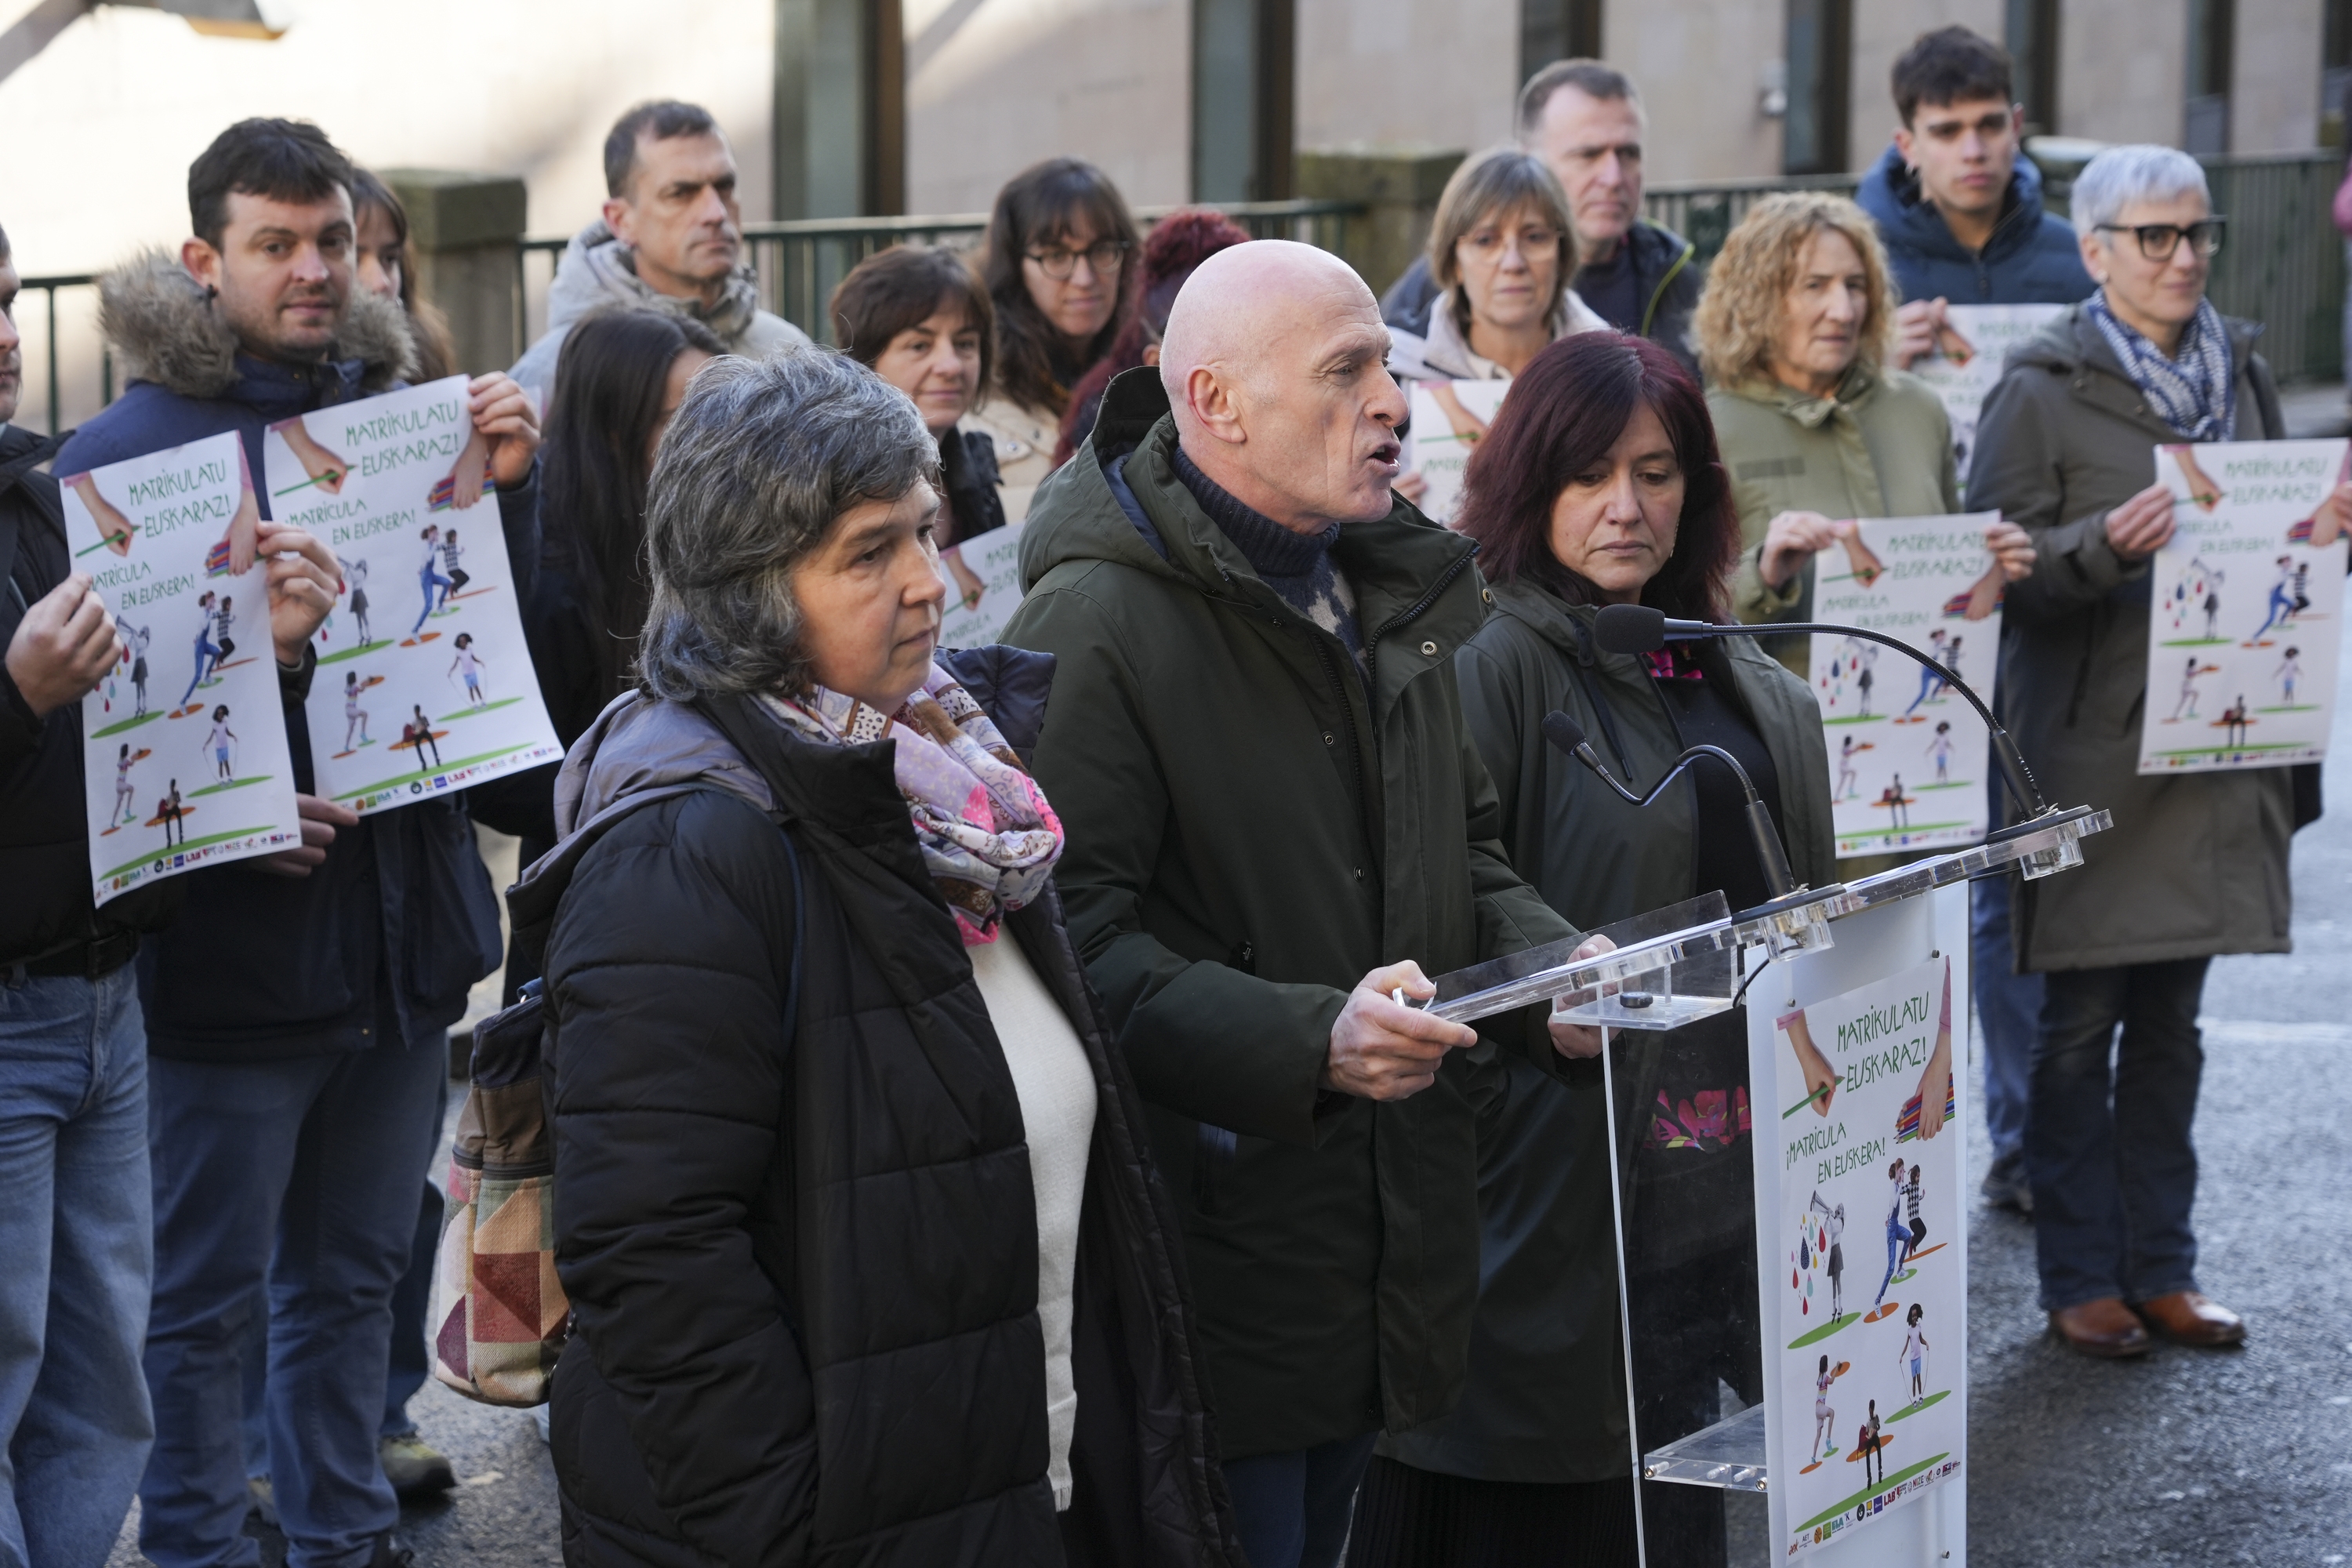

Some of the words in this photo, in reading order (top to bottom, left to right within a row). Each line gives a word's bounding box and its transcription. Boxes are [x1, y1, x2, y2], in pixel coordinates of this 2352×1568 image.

[361, 432, 459, 477] EUSKARAZ!
[143, 493, 231, 539] EUSKARAZ!
[332, 526, 350, 546] EN
[354, 508, 416, 540] EUSKERA!
[122, 590, 136, 611] EN
[140, 572, 195, 605] EUSKERA!
[1846, 1036, 1926, 1093] EUSKARAZ!
[1818, 1159, 1831, 1185] EN
[1835, 1137, 1885, 1178] EUSKERA!
